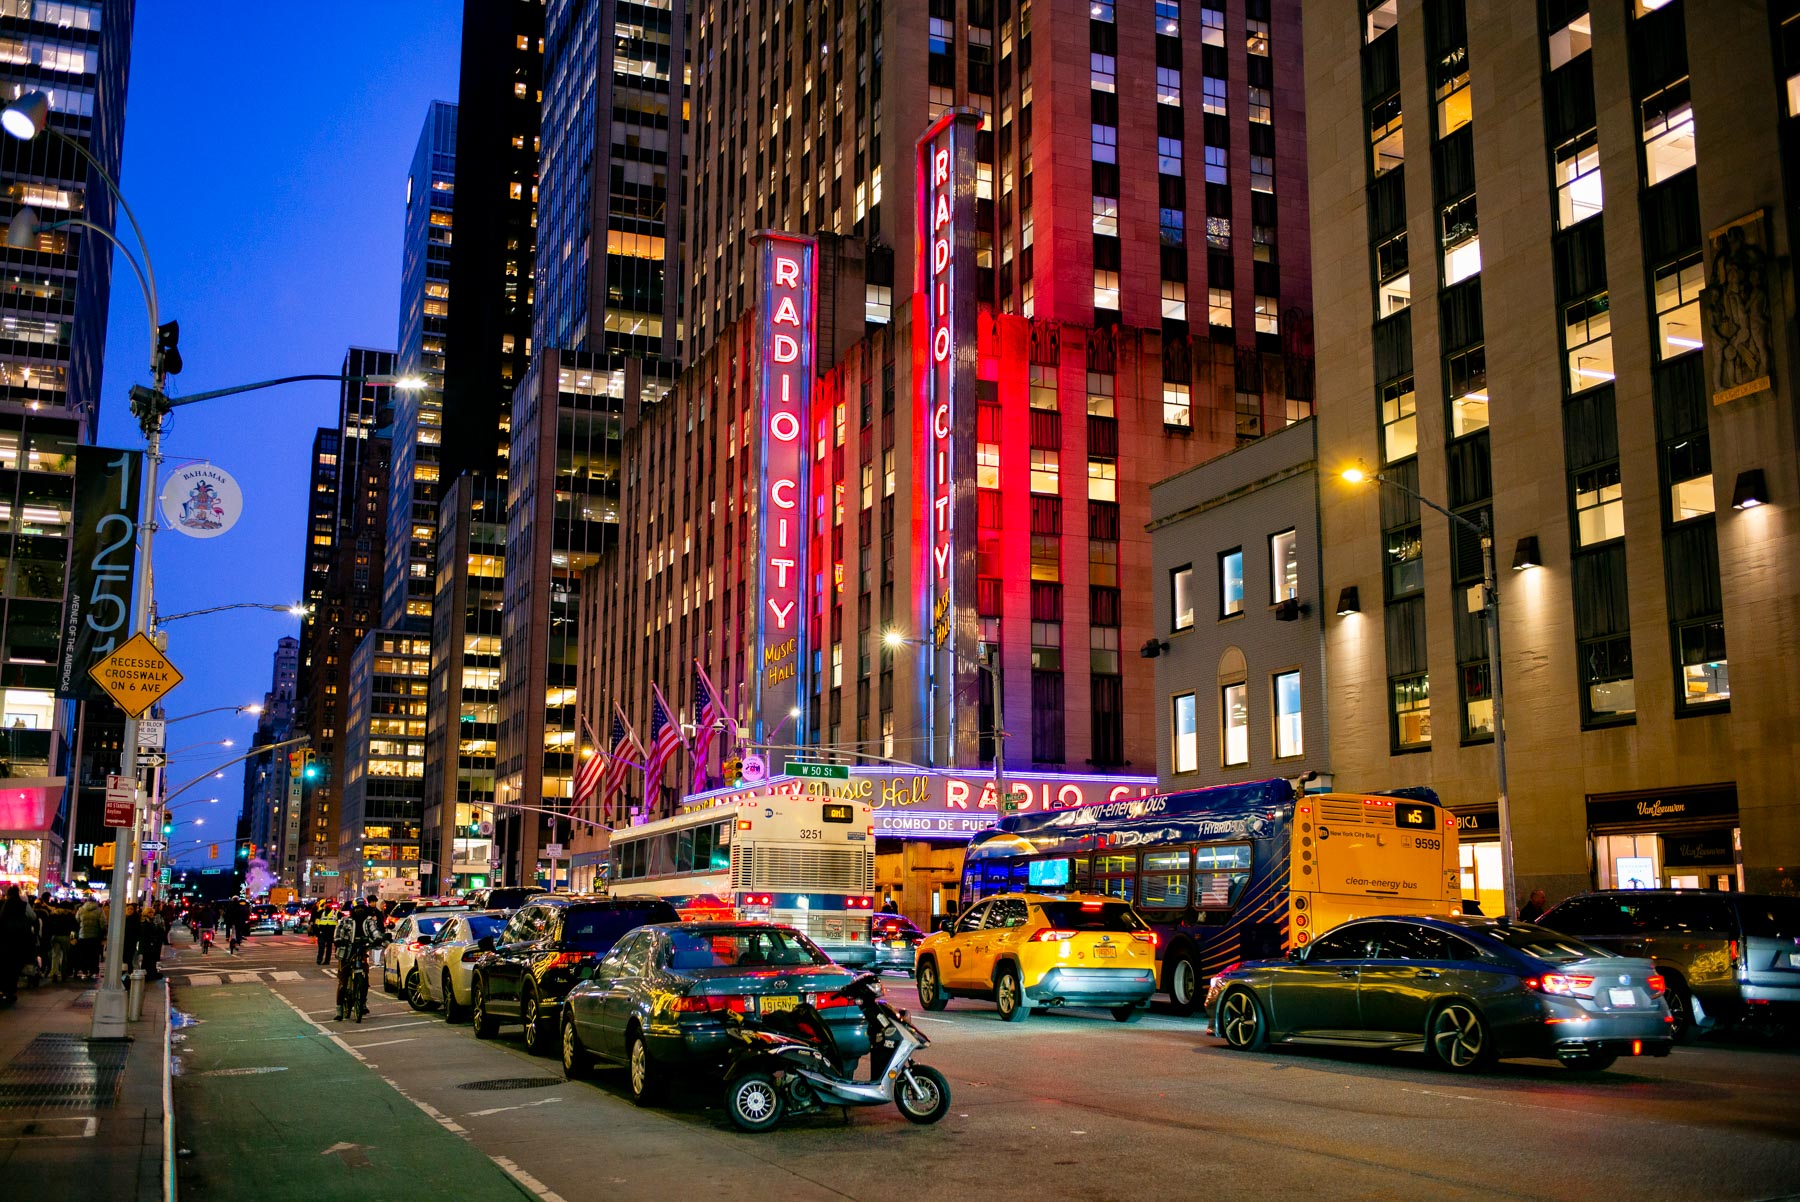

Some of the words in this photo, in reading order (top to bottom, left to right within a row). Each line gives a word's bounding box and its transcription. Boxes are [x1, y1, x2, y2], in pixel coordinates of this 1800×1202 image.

[935, 149, 949, 361] RADIO
[771, 257, 799, 441] RADIO
[183, 471, 226, 483] BAHAMAS
[935, 404, 949, 579] CITY
[87, 452, 132, 653] 125
[768, 480, 795, 628] CITY
[71, 594, 80, 623] AVENUE
[69, 624, 77, 636] OF
[67, 637, 75, 653] THE
[111, 658, 164, 669] RECESSED
[61, 654, 74, 691] AMERICAS
[105, 669, 168, 681] CROSSWALK
[111, 681, 125, 690] ON
[129, 683, 136, 691] 6
[141, 684, 161, 692] AVE
[802, 766, 809, 775] W
[811, 767, 821, 775] 50
[824, 767, 832, 776] St
[868, 775, 930, 809] Hall
[946, 780, 1083, 810] RADIO
[1145, 795, 1168, 812] bus
[883, 818, 930, 829] COMBO
[938, 819, 954, 830] DE
[800, 829, 822, 839] 3251
[1415, 837, 1441, 850] 9599
[1345, 876, 1401, 890] clean-energy
[1402, 879, 1418, 889] bus
